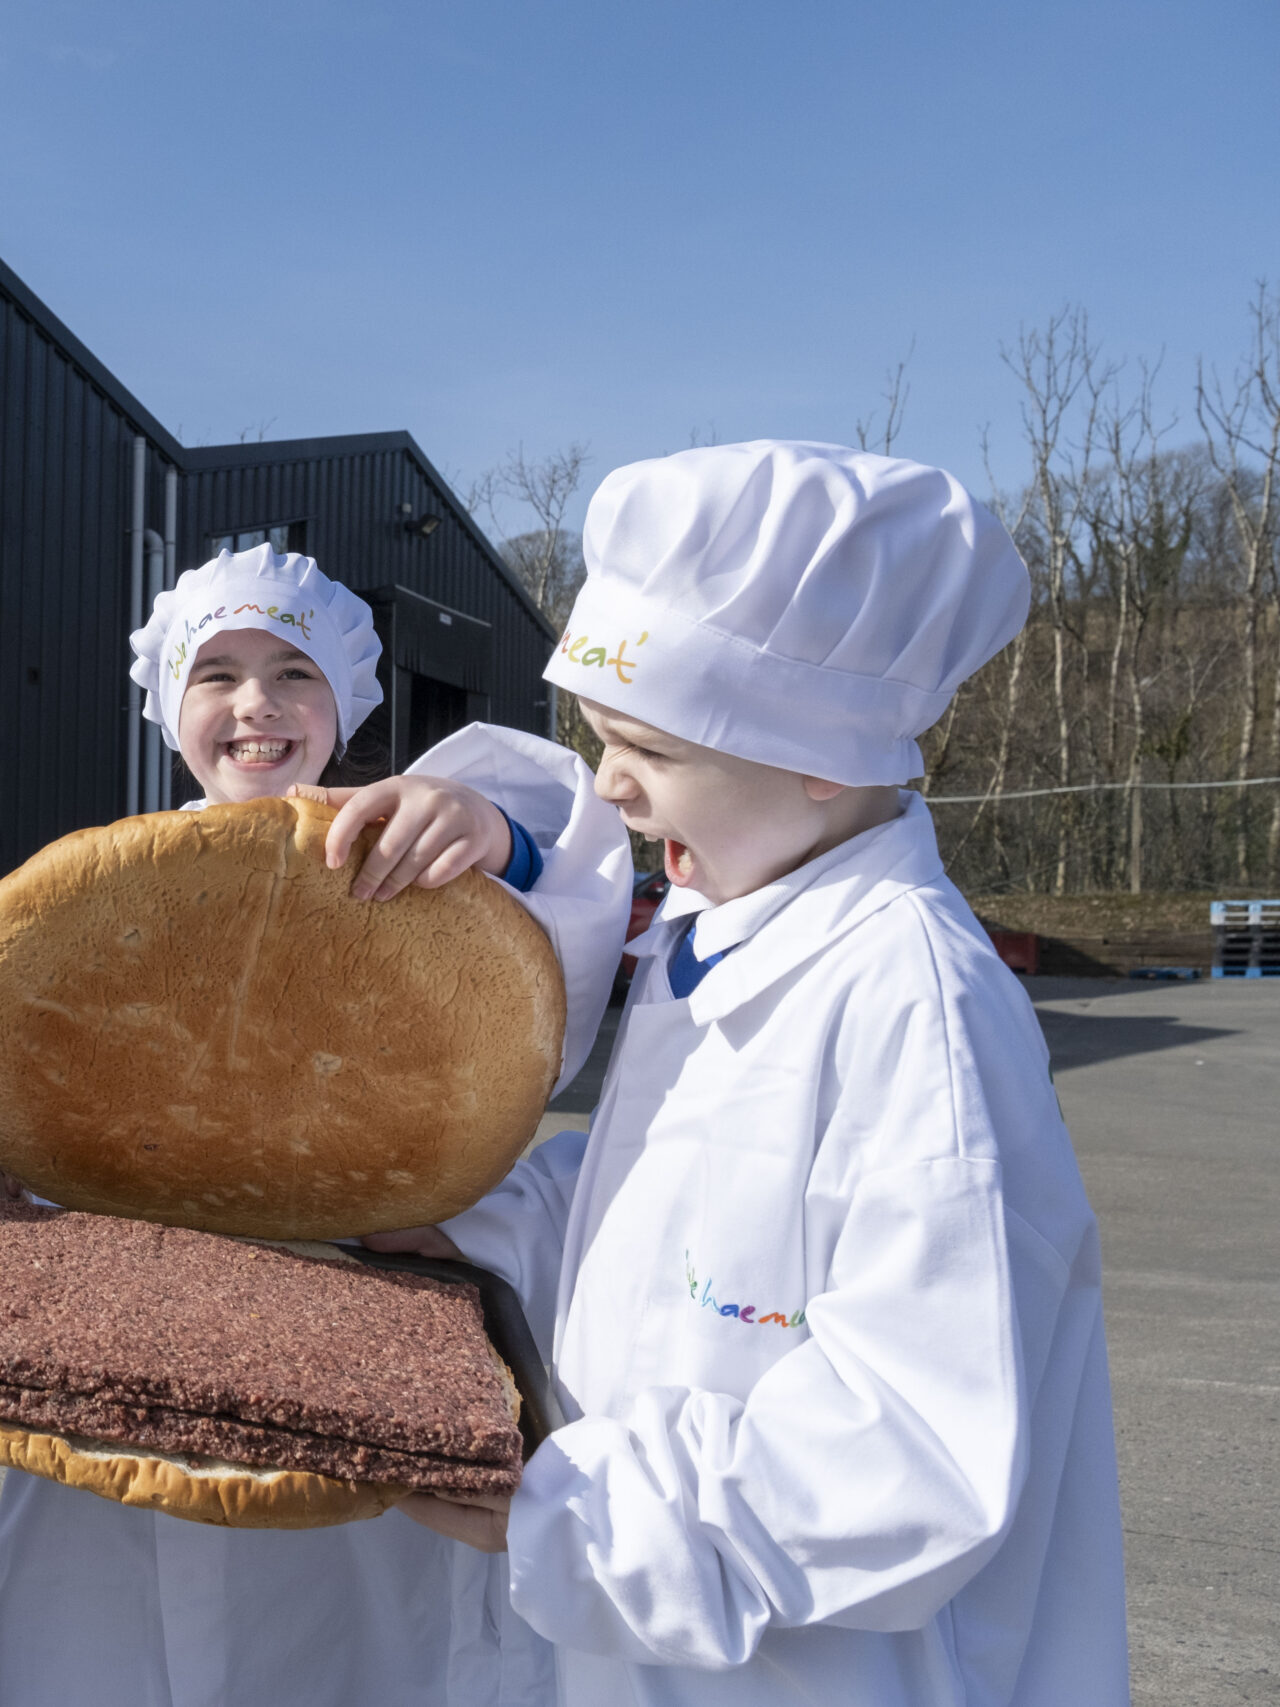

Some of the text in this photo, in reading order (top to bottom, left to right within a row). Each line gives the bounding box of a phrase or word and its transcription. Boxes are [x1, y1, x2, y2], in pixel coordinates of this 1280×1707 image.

[185, 605, 227, 643] hae
[233, 603, 315, 641] meat'
[701, 1277, 756, 1324] hae
